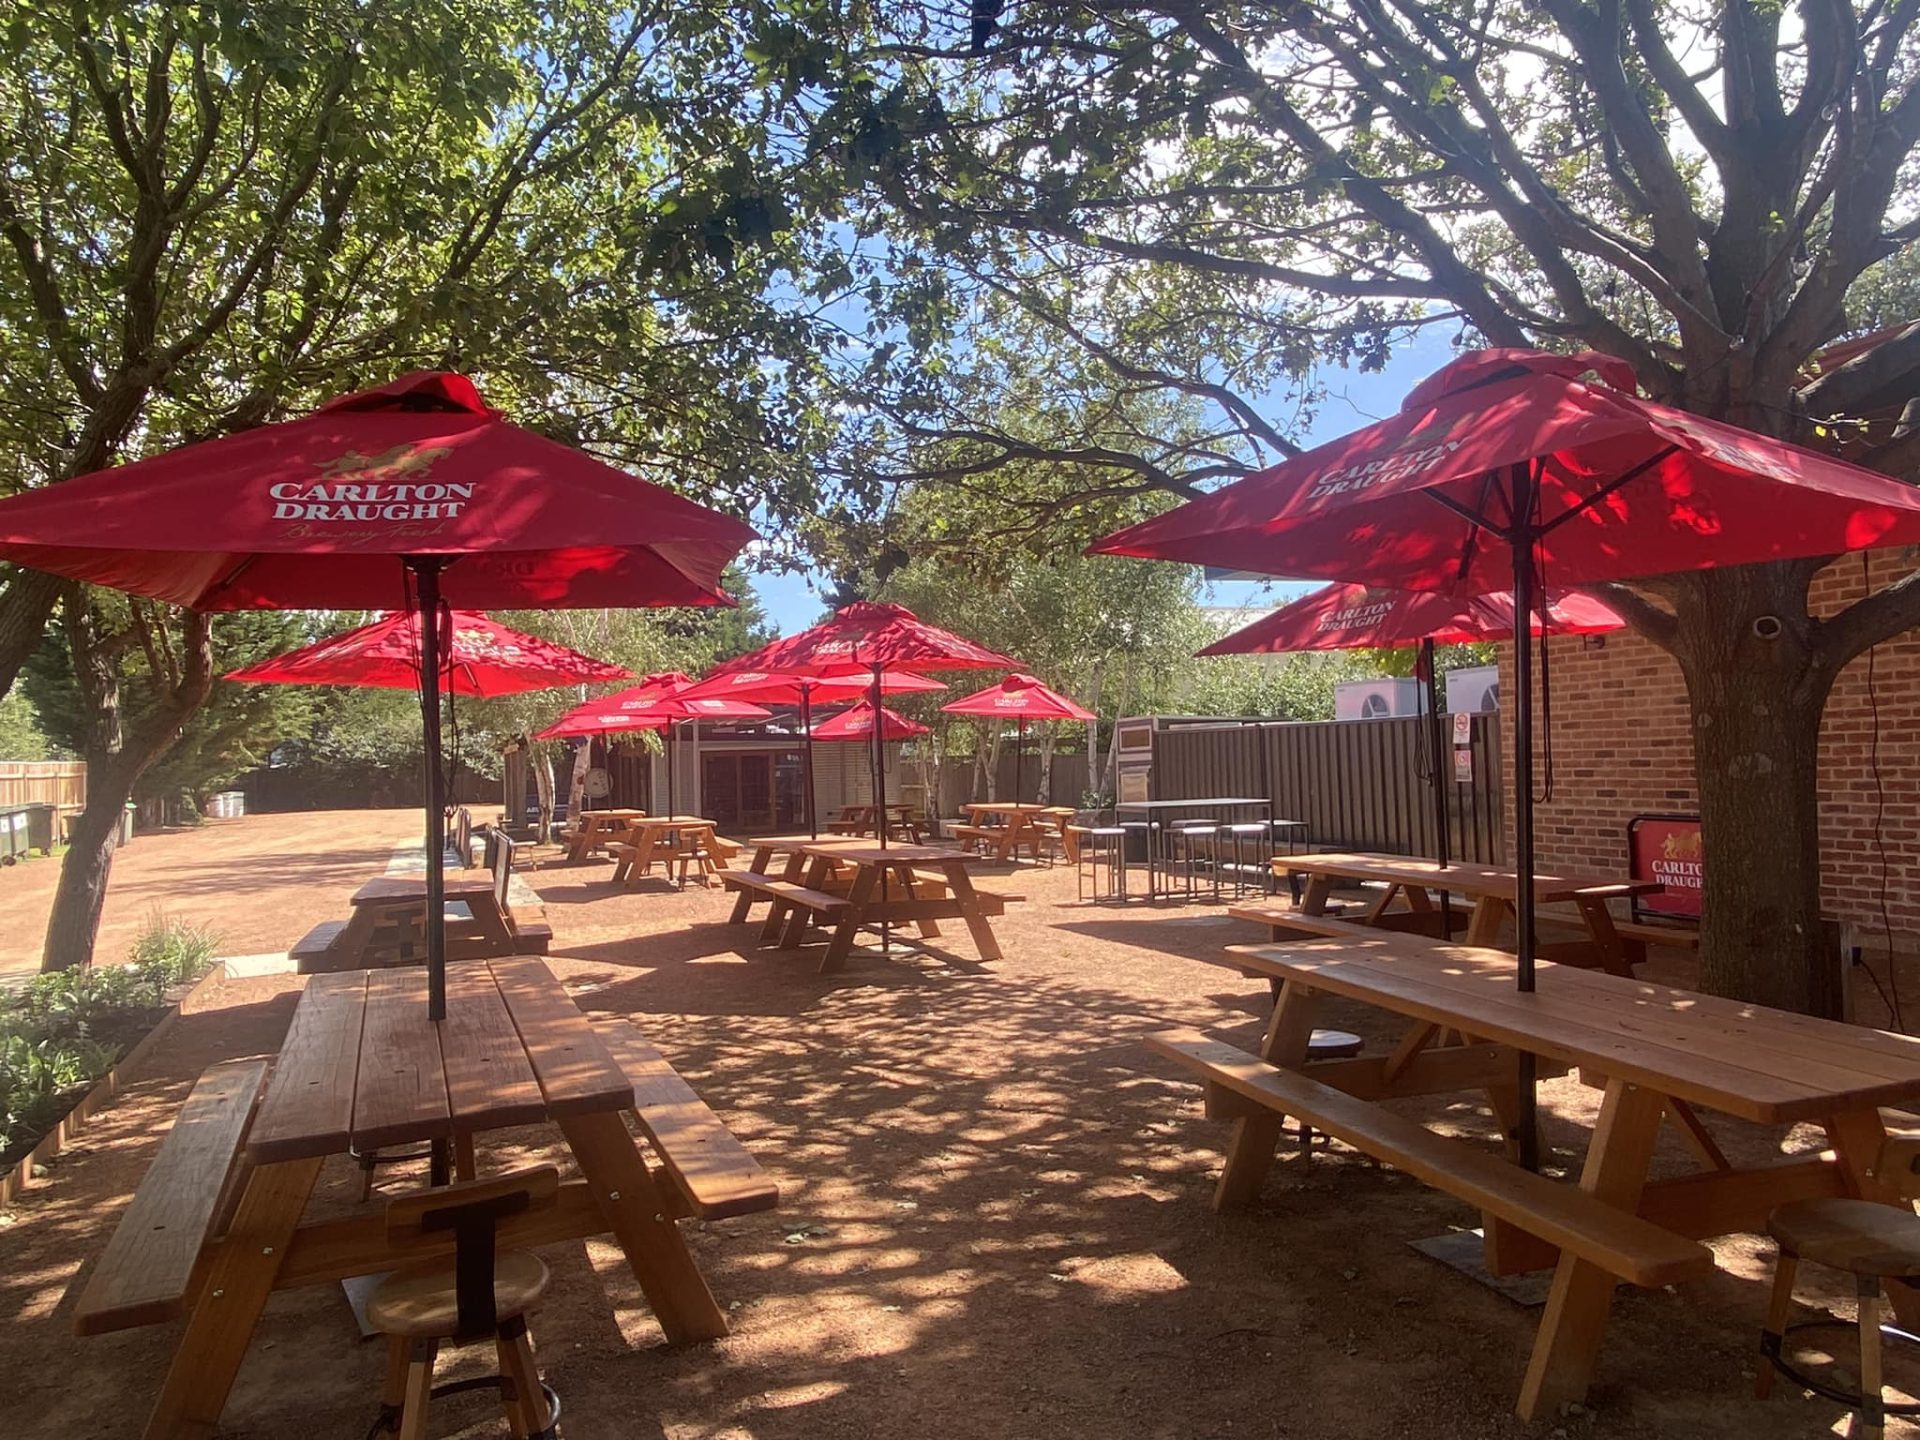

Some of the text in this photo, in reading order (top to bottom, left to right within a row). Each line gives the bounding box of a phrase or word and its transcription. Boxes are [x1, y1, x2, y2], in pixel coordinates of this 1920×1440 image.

[1318, 437, 1469, 484] CARLTON
[1306, 455, 1446, 499] DRAUGHT
[269, 482, 477, 502] CARLTON
[272, 502, 466, 521] DRAUGHT
[1320, 600, 1398, 623] CARLTON
[1316, 613, 1388, 632] DRAUGHT
[1651, 860, 1703, 876] CARLTO
[1655, 874, 1703, 888] DRAUGH
